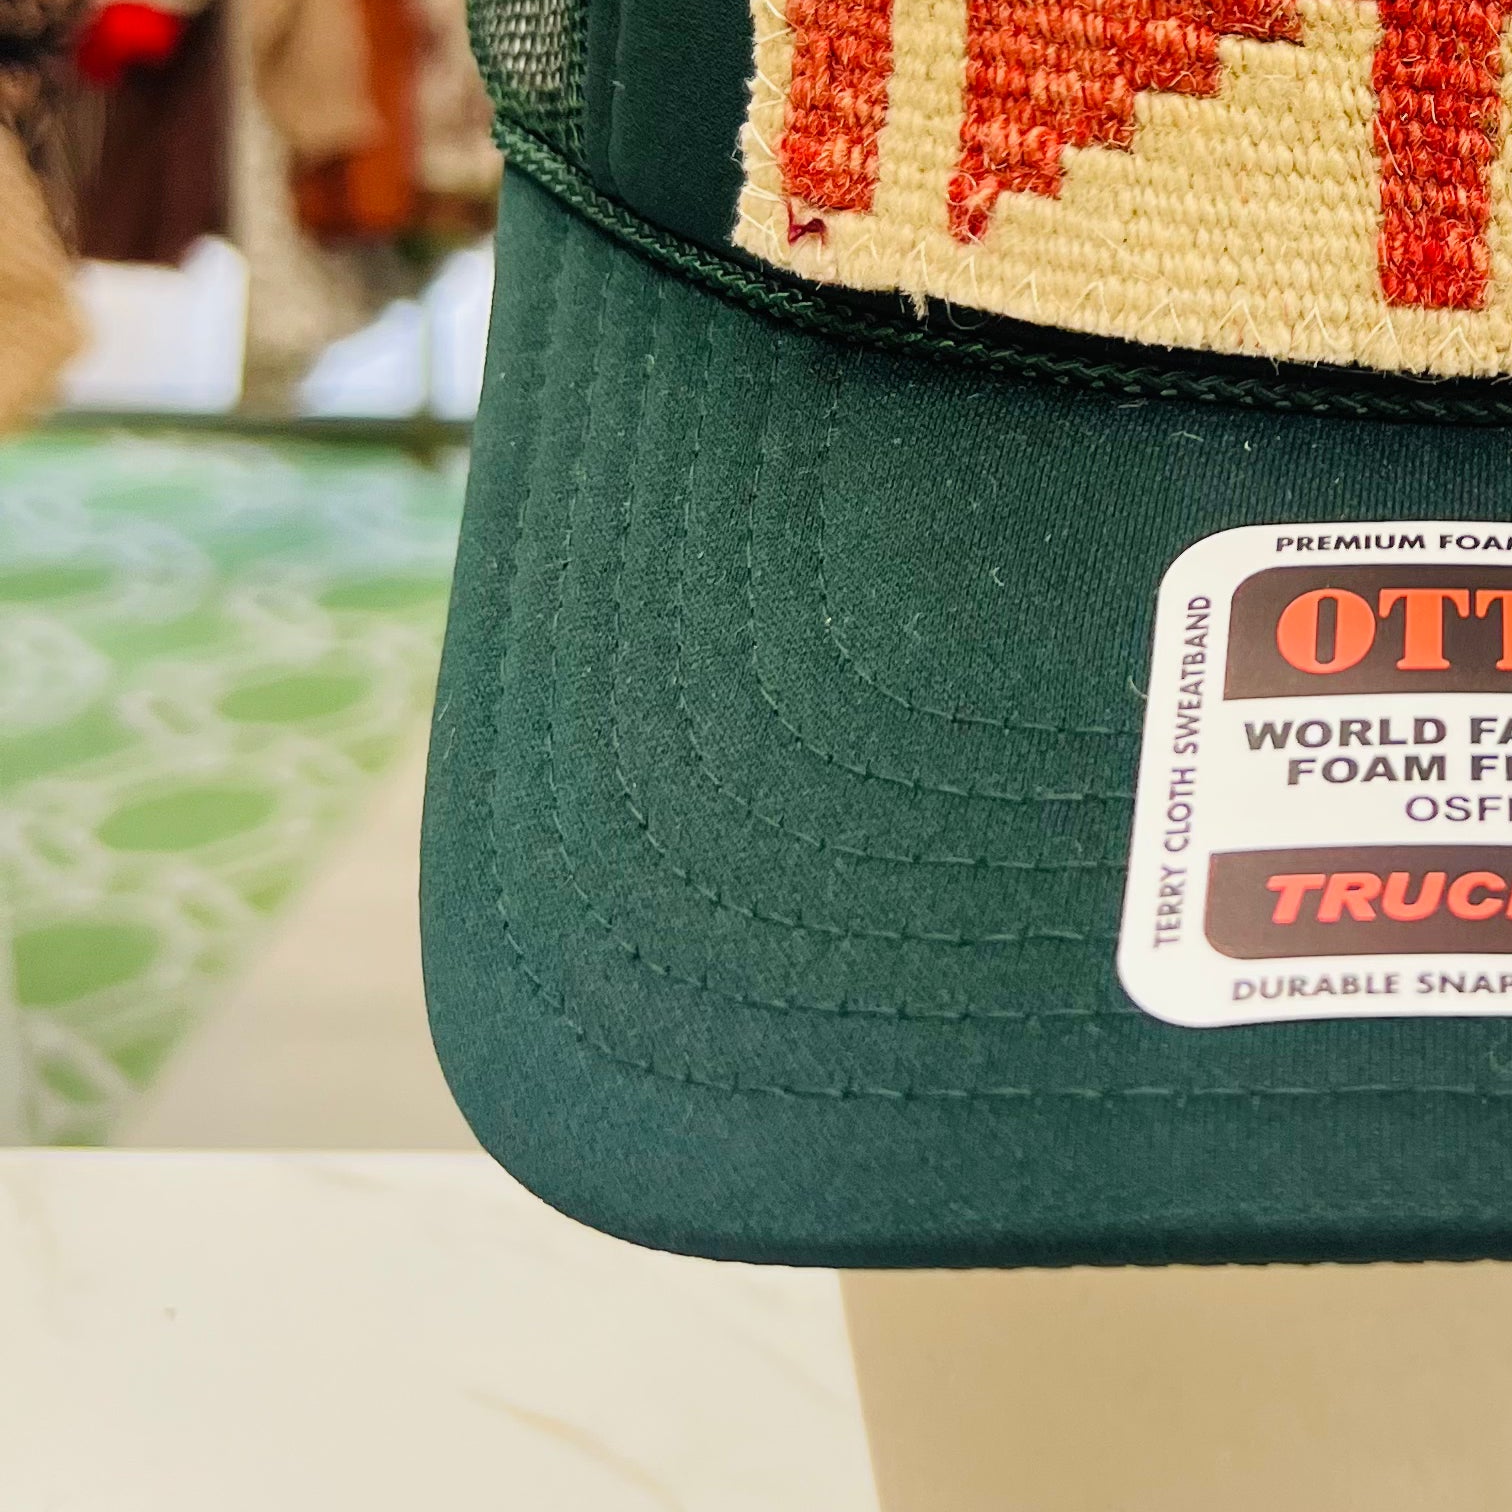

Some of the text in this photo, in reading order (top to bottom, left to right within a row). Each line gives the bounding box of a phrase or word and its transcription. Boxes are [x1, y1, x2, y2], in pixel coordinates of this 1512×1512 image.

[1276, 534, 1426, 553] PREMIUM
[1244, 717, 1446, 751] WORLD
[1153, 596, 1211, 949] TERRY CLOTH SWEATBAND
[1287, 755, 1447, 785] FOAM
[1232, 972, 1400, 1001] DURABLE
